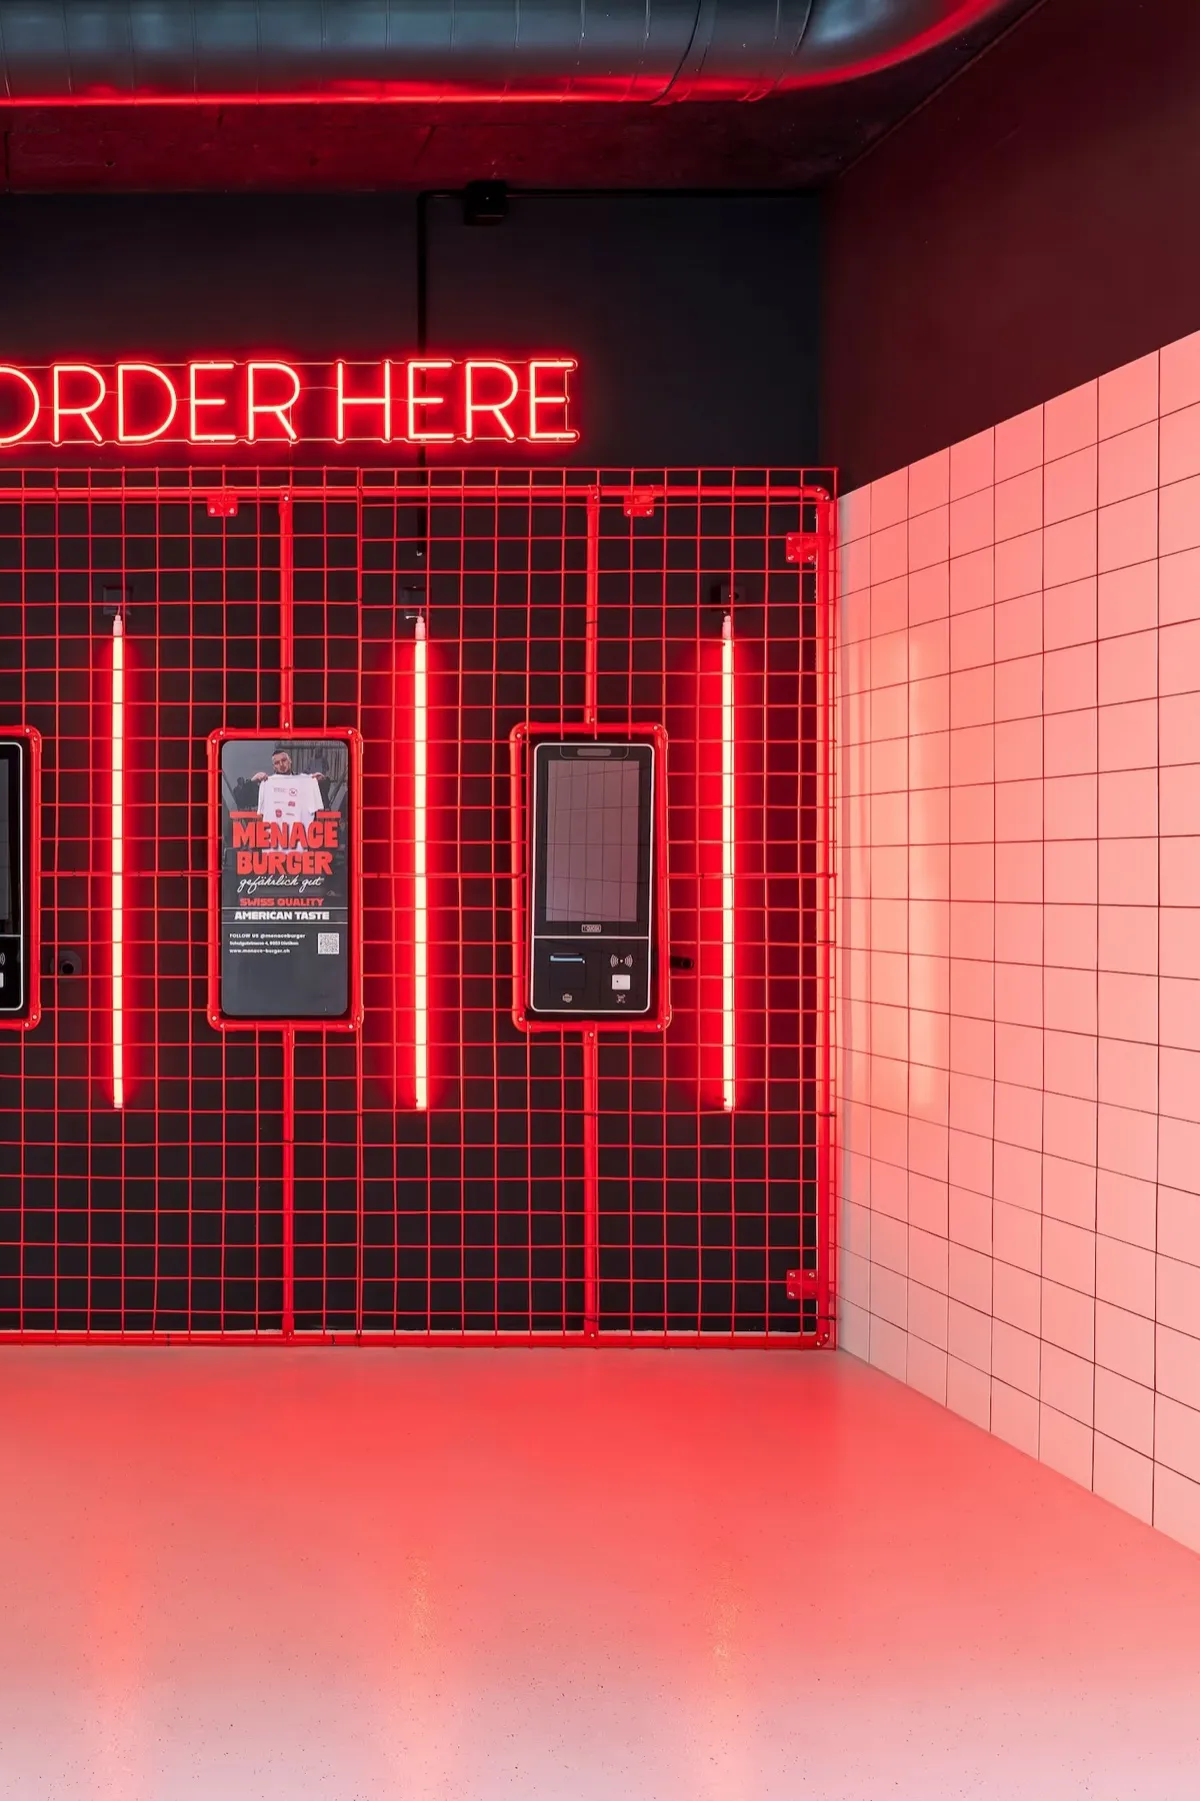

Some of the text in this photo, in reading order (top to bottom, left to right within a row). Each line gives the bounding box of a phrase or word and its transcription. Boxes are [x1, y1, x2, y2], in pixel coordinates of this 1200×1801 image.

[337, 361, 577, 440] HERE
[232, 821, 338, 848] MENACE
[237, 851, 333, 875] BURGER
[237, 874, 323, 894] gefährlich gut
[239, 898, 324, 907] SWISS QUALITY
[234, 911, 329, 920] AMERICAN TASTE
